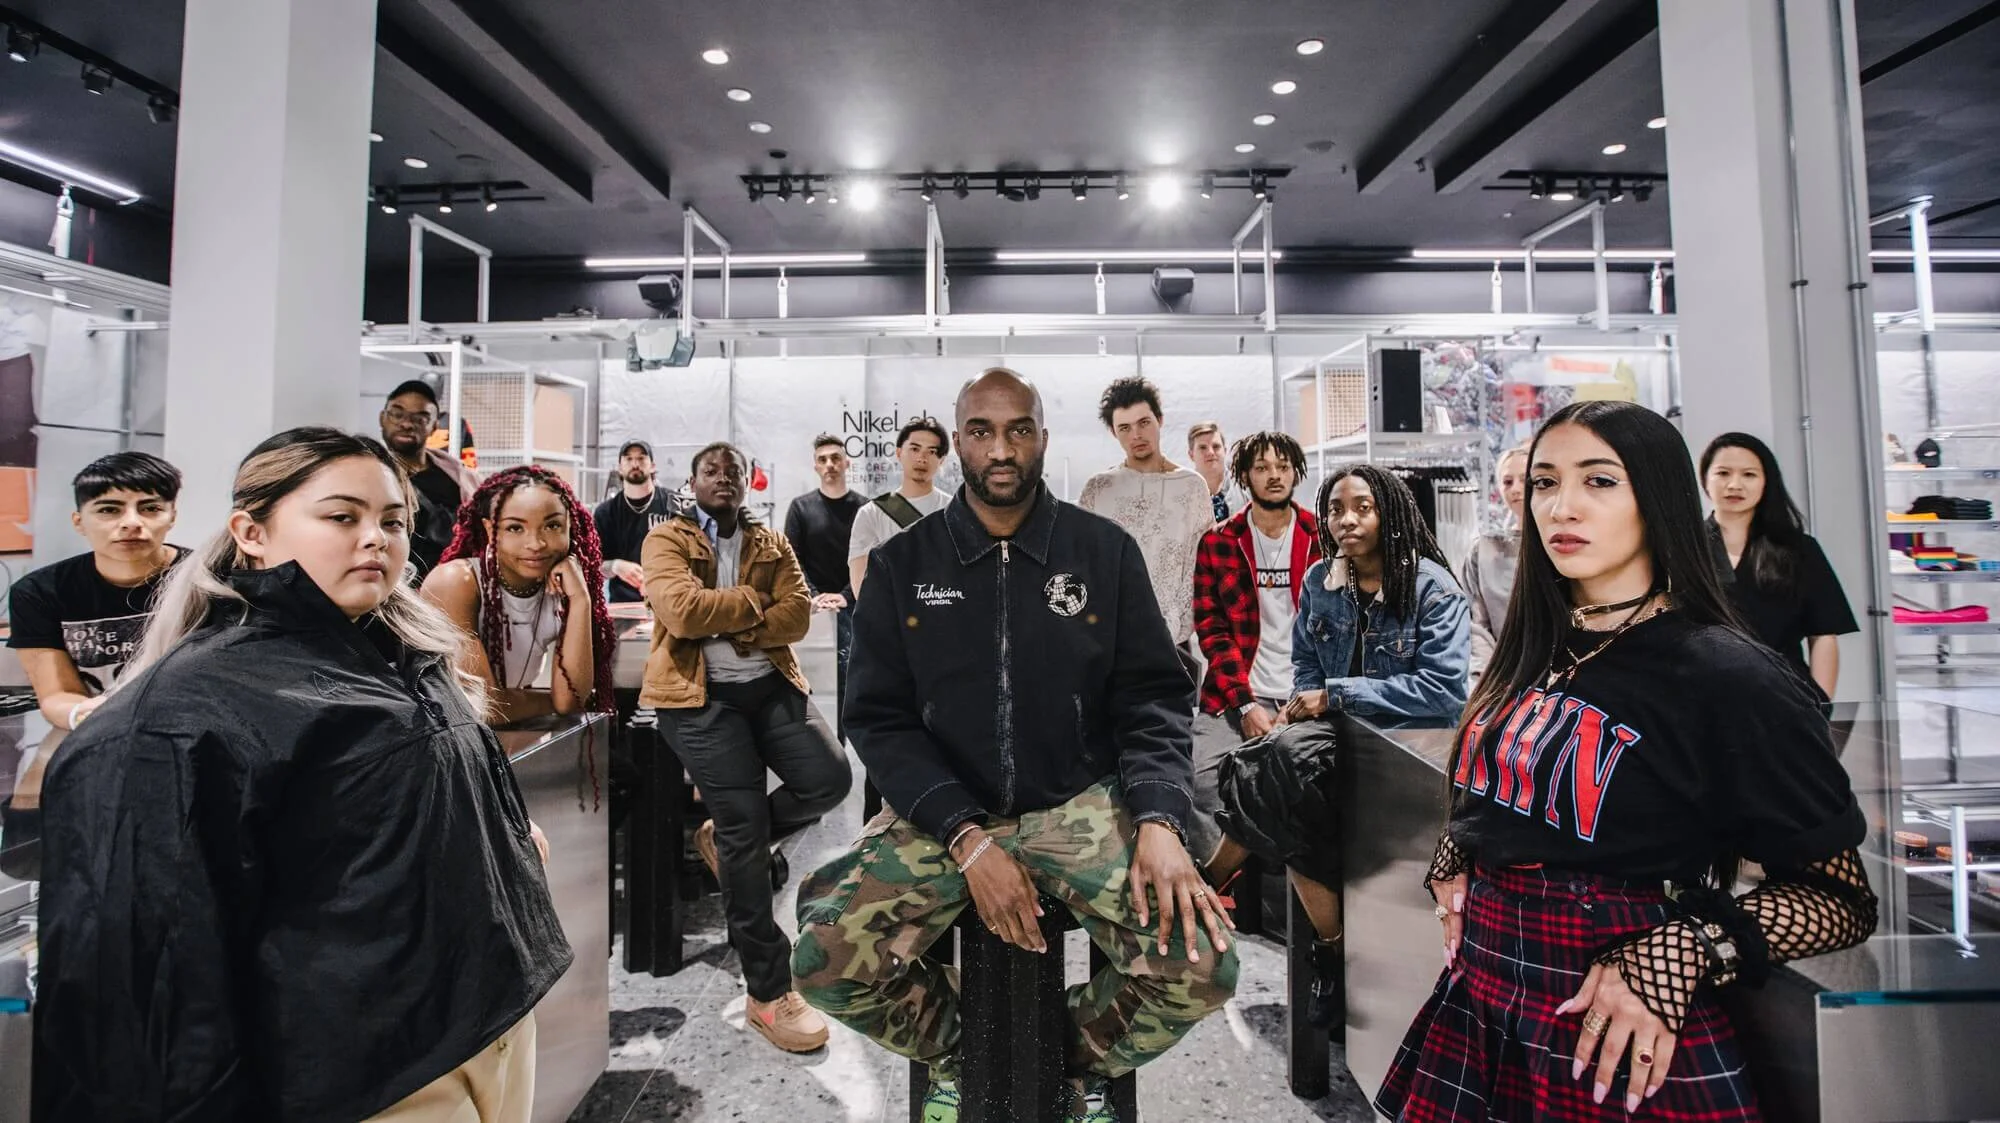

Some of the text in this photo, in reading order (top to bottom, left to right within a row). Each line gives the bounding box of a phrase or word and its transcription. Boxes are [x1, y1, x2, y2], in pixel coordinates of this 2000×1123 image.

[844, 435, 896, 458] Chic
[913, 584, 966, 599] Technician
[66, 639, 134, 656] MANOR
